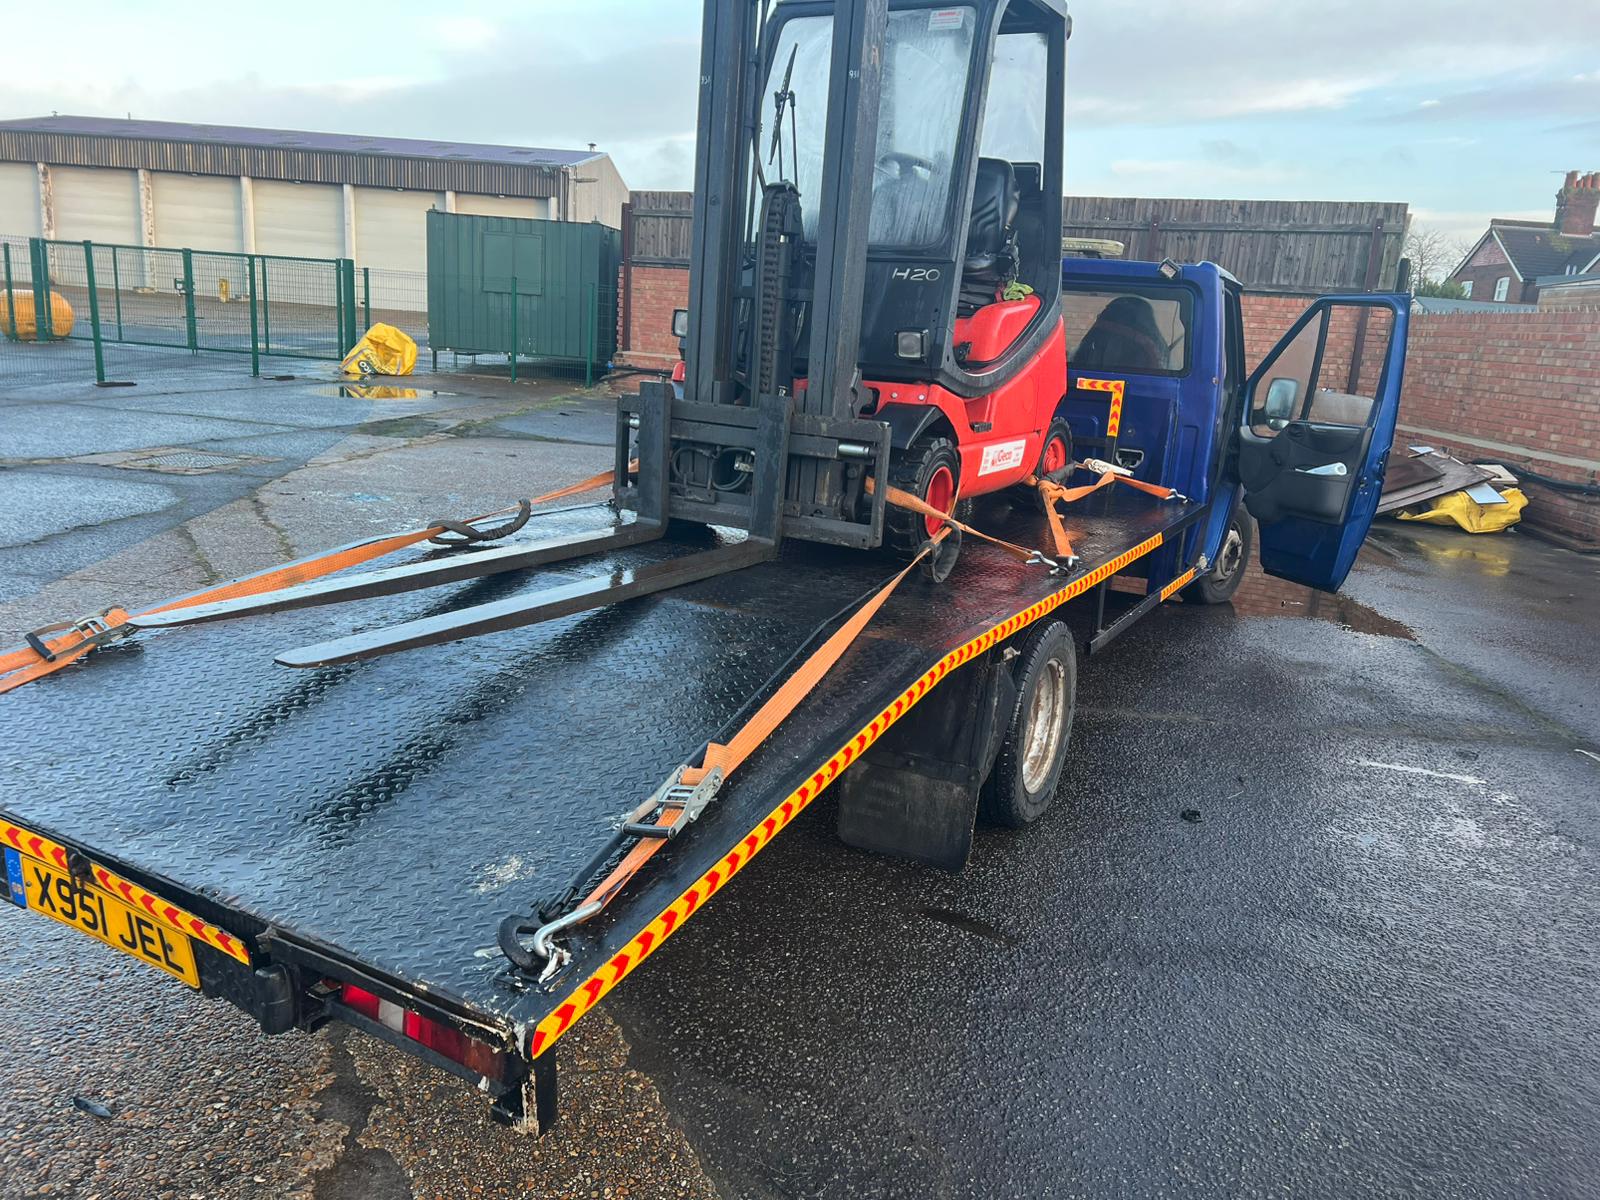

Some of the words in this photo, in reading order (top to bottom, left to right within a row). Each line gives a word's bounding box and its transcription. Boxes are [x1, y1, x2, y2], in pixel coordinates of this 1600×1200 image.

[891, 267, 941, 282] H20
[33, 866, 109, 937] X951
[118, 911, 185, 975] JEL
